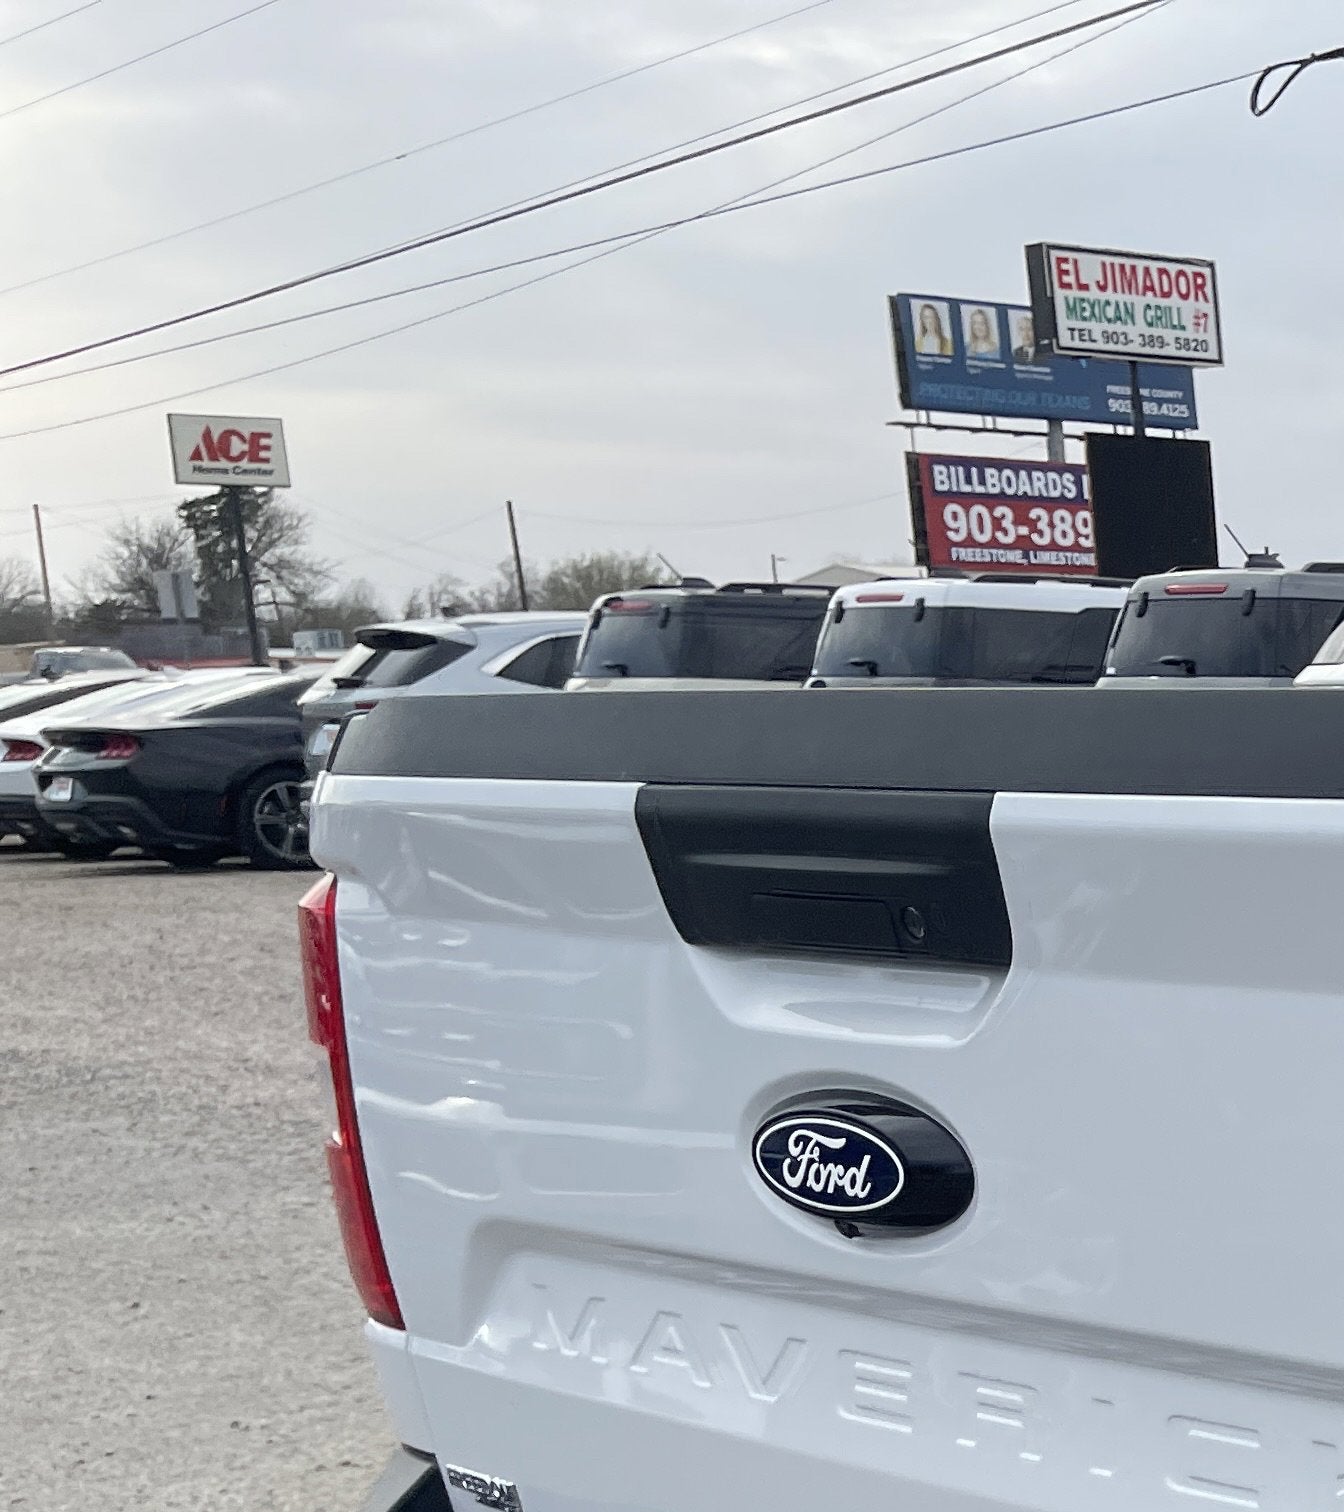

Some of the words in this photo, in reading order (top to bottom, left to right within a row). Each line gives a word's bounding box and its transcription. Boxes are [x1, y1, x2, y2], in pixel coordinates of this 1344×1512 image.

[1055, 256, 1090, 292] EL
[1095, 260, 1210, 304] JIMADOR
[1063, 295, 1136, 326] MEXICAN
[1143, 303, 1186, 332] GRILL
[1067, 327, 1098, 343] TEL
[1174, 336, 1209, 353] 5820
[188, 423, 273, 464] ACE
[932, 464, 1078, 499] BILLBOARDS
[782, 1128, 872, 1200] Ford
